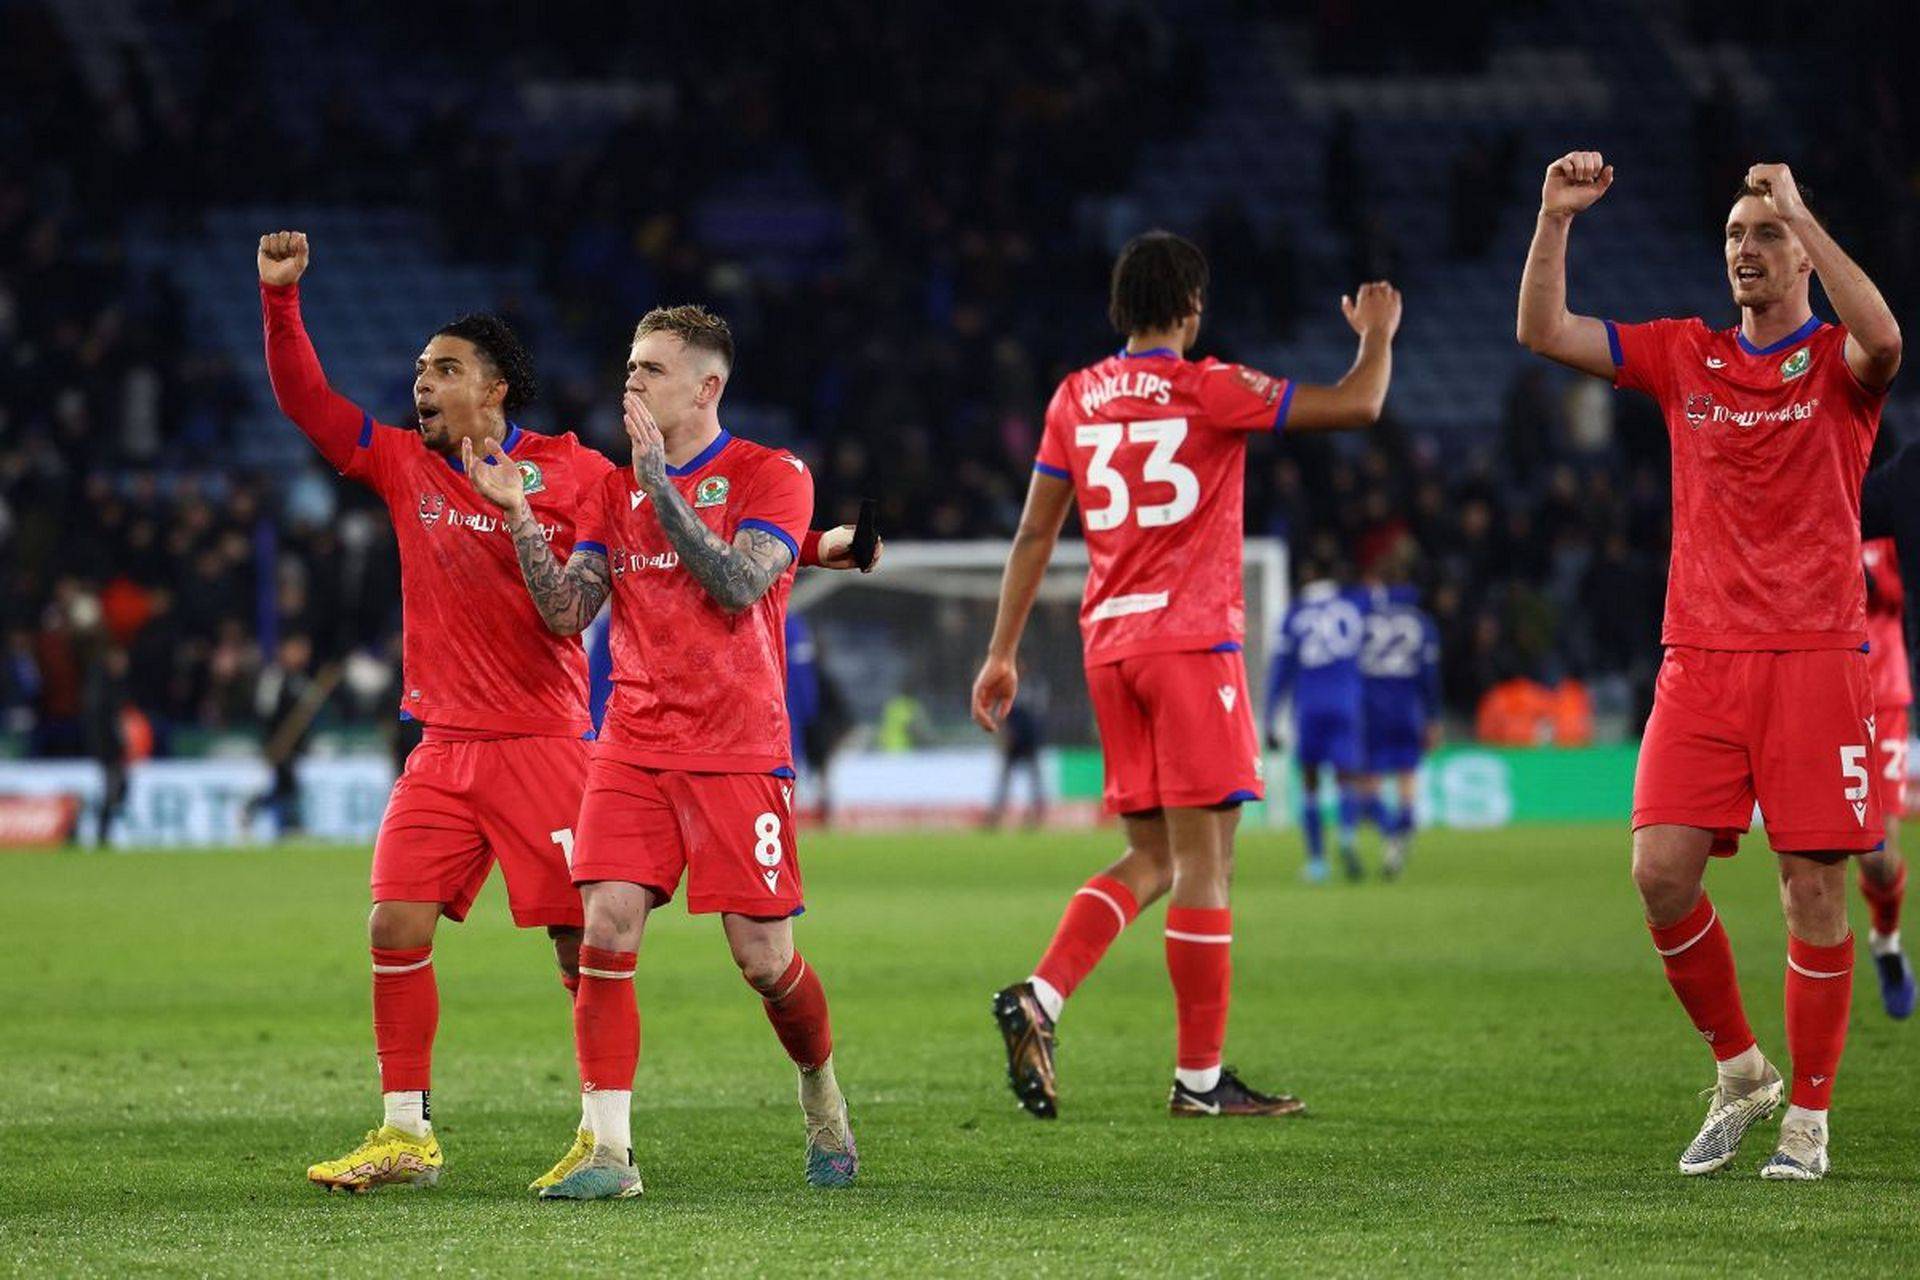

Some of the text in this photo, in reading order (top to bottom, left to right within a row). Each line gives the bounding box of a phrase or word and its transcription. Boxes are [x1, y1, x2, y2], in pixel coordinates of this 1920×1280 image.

[1081, 371, 1171, 417] PHILLIPS
[1075, 417, 1199, 531] 33
[1289, 600, 1364, 668] 20
[1362, 613, 1424, 678] 22
[1840, 745, 1869, 800] 5
[754, 812, 782, 867] 8
